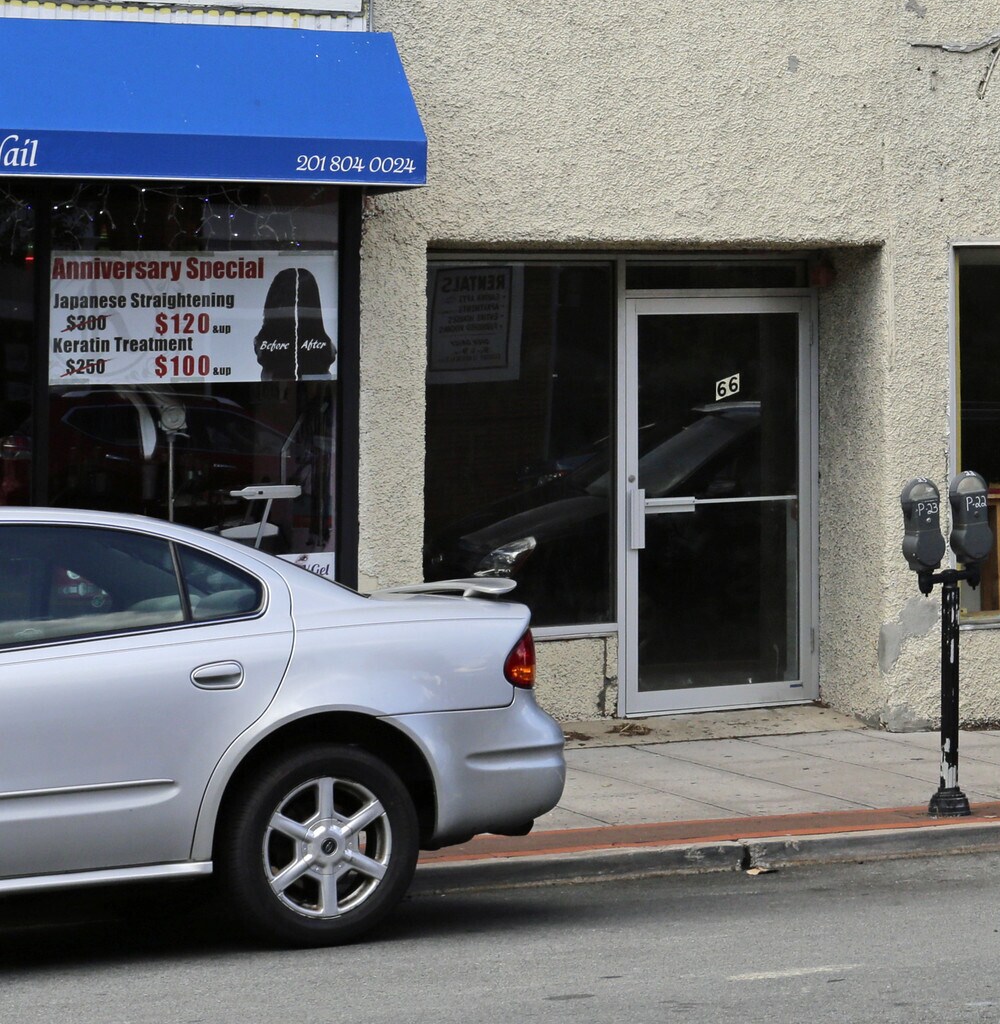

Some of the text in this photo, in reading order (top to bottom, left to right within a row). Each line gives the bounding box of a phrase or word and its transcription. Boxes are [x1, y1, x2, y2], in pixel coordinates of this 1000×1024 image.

[296, 154, 416, 174] 201 804 0024
[52, 257, 264, 281] Anniversary Special
[53, 292, 235, 310] Japanese Straightening
[66, 312, 232, 335] $300 $120 &up
[52, 336, 193, 353] Keratin Treatment
[259, 339, 327, 351] Before After
[65, 354, 232, 378] $250 $100 &up
[716, 376, 739, 397] 66
